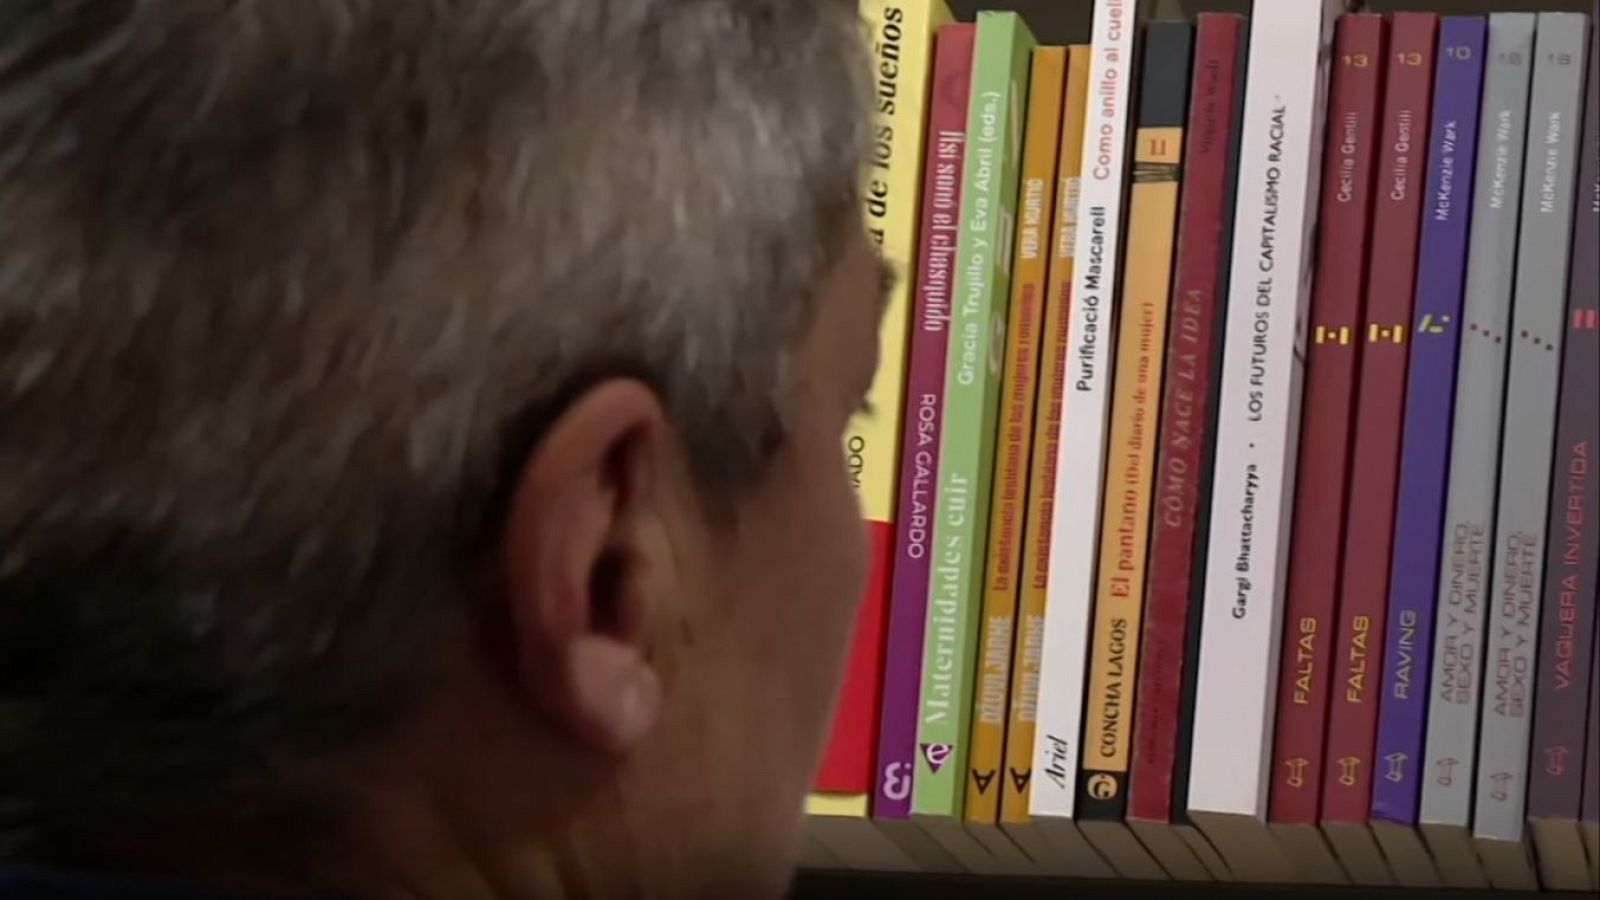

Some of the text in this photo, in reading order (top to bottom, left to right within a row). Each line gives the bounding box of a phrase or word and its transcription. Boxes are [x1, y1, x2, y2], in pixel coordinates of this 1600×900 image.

[877, 7, 903, 116] sueños
[1104, 48, 1119, 62] al
[1342, 55, 1368, 67] 13
[1397, 52, 1423, 65] 13
[1447, 47, 1471, 60] 10
[1099, 69, 1118, 118] anillo
[871, 125, 893, 172] los
[1093, 124, 1113, 180] Como
[1390, 156, 1408, 200] Cecilia
[1435, 120, 1457, 221] McKenzie Wark
[1489, 109, 1511, 208] McKenzie Wark
[1540, 111, 1561, 213] McKenzie Wark
[866, 180, 889, 218] de
[1337, 158, 1354, 202] Cecilia
[931, 213, 957, 230] el
[958, 91, 1001, 386] Gracia Trujillo y Eva Abril (eds.)
[923, 235, 956, 331] chasquido
[1247, 105, 1286, 422] LOS FUTUROS DEL CAPITALISMO RACIAL
[1077, 206, 1105, 391] Purificació Mascarell
[1184, 288, 1202, 343] IDEA
[1131, 387, 1147, 404] de
[1136, 356, 1149, 383] una
[1177, 354, 1197, 381] LA
[1127, 407, 1145, 450] diario
[1171, 388, 1194, 450] NACE
[908, 394, 936, 558] ROSA GALLARDO
[1117, 489, 1139, 570] pantano
[1232, 464, 1257, 620] Gargi Bhattacharyya
[1111, 572, 1131, 598] El
[1554, 440, 1588, 690] VAQUERA INVERTIDA
[926, 473, 968, 725] Maternidades cuir
[1447, 614, 1459, 627] Y
[1456, 523, 1485, 705] SEXO Y MUERTE
[1509, 534, 1537, 718] SEXO Y MUERTE
[1107, 618, 1128, 676] LAGOS
[1295, 617, 1317, 704] FALTAS
[1347, 615, 1369, 703] FALTAS
[1394, 609, 1416, 699] RAVING
[1500, 625, 1512, 639] Y
[1441, 634, 1459, 704] AMOR
[1494, 647, 1513, 717] AMOR
[1100, 681, 1122, 757] CONCHA
[1045, 734, 1067, 789] Ariel
